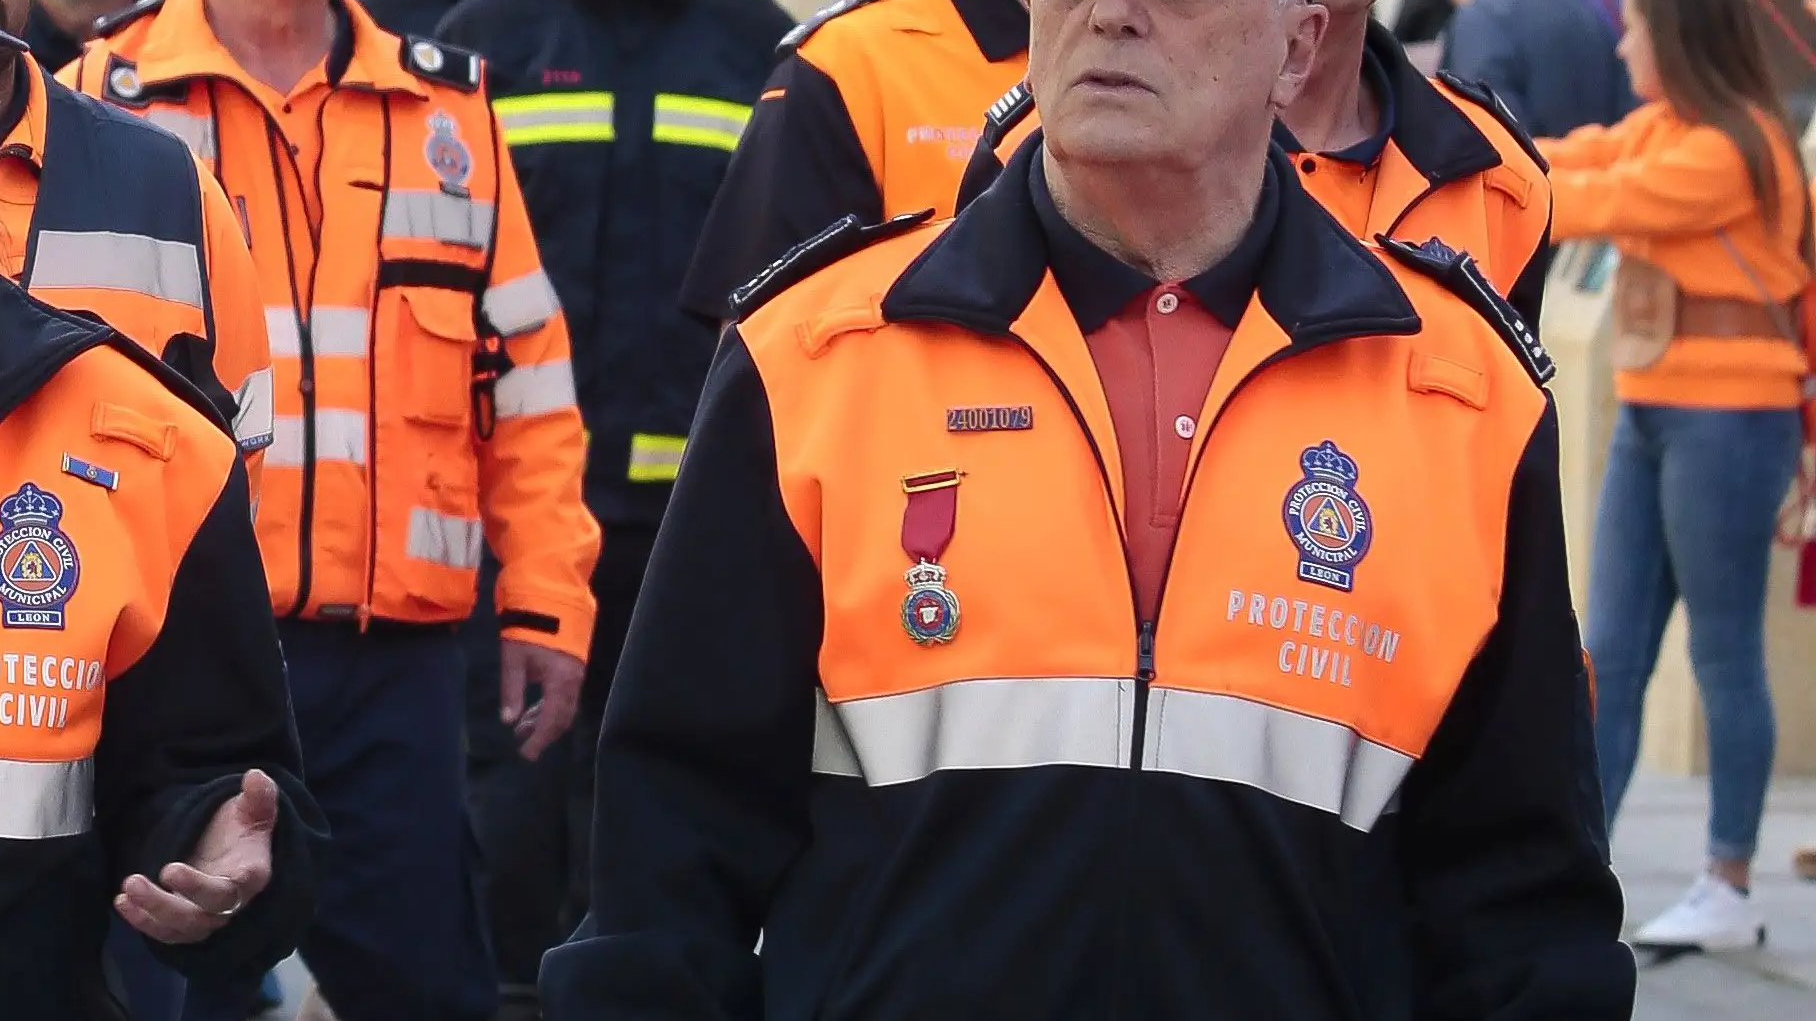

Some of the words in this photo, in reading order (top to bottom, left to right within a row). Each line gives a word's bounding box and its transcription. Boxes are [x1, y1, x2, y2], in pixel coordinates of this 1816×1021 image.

[948, 406, 1031, 430] 24001079
[1289, 482, 1348, 516] PROTECCION
[1348, 499, 1367, 534] CIVIL
[53, 538, 74, 571] CIVIL
[1295, 531, 1358, 563] MUNICIPAL
[1309, 566, 1341, 583] LEON
[18, 613, 51, 624] LEON
[1278, 640, 1353, 687] CIVIL
